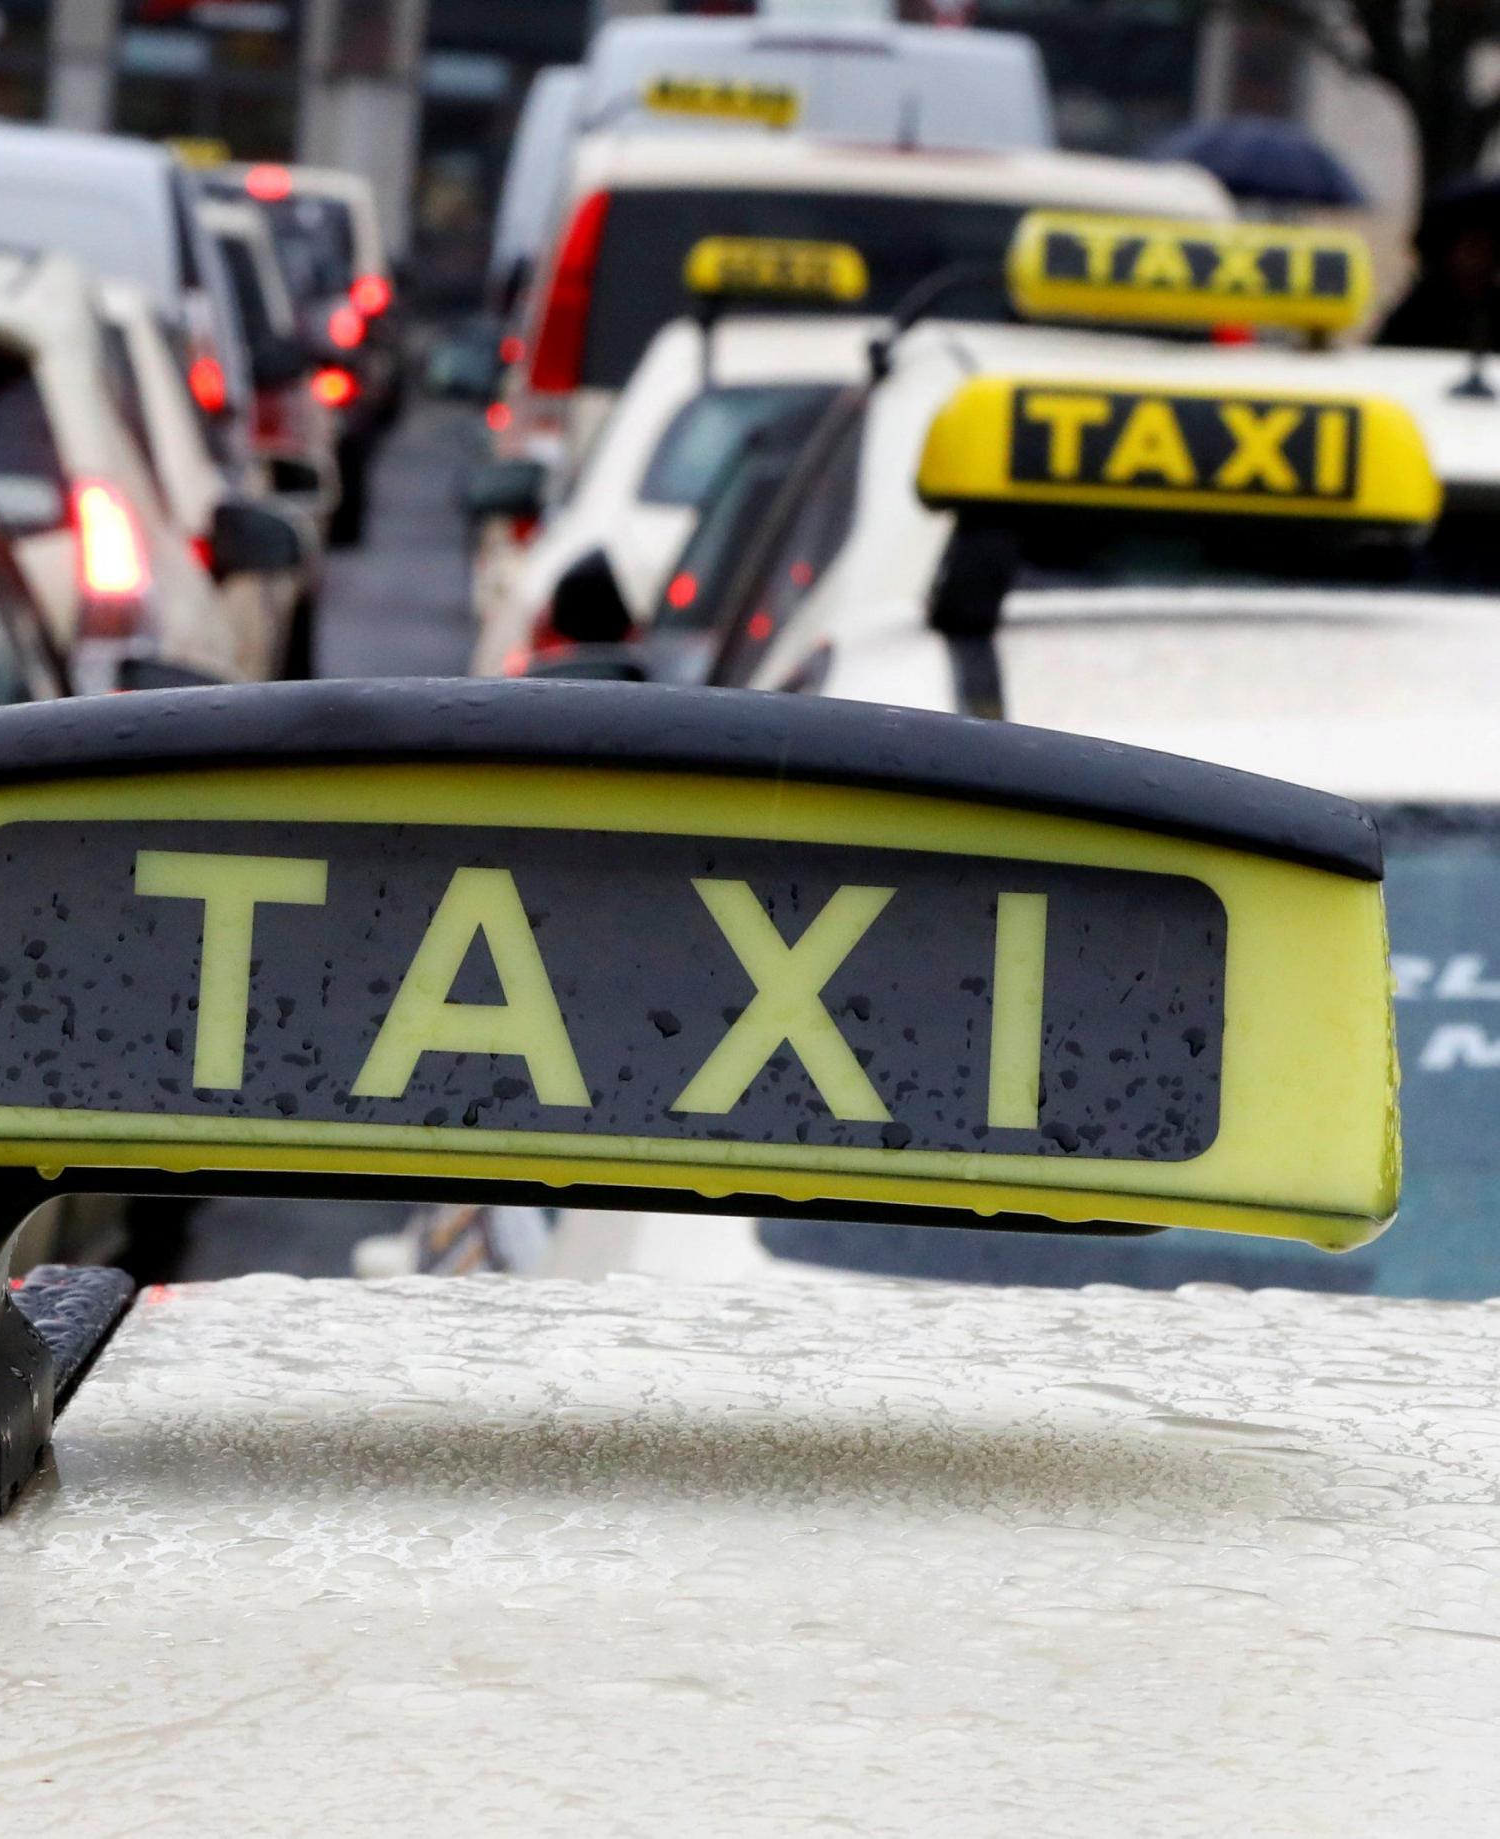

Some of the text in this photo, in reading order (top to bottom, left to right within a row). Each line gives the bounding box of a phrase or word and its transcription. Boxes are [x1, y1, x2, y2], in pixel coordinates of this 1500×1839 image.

[1064, 229, 1314, 299] TAXI
[1023, 393, 1348, 497] TAXI
[134, 849, 1048, 1130] TAXI
